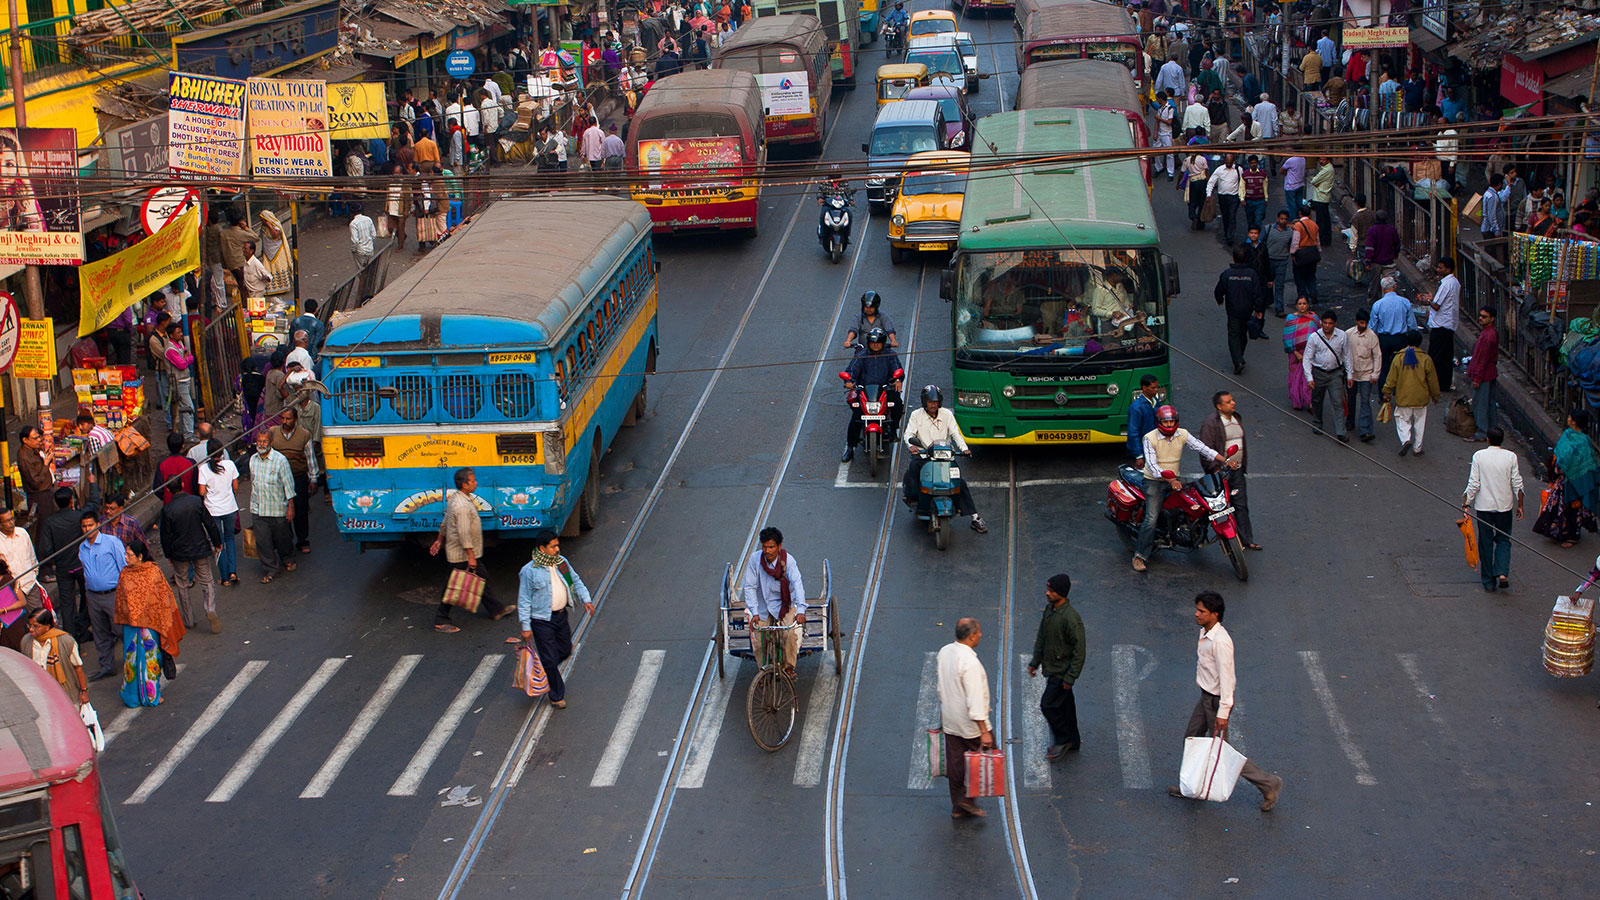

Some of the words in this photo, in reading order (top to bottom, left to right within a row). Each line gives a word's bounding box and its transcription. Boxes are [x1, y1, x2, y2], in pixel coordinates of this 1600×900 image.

[1367, 30, 1391, 38] Meghraj
[170, 75, 245, 108] ABHISHEK
[249, 81, 284, 97] ROYAL
[286, 83, 323, 98] TOUCH
[171, 99, 241, 118] SHERWANI
[249, 99, 296, 112] CREATIONS
[297, 100, 308, 113] (P)
[192, 116, 216, 126] HOUSE
[217, 120, 227, 128] OF
[173, 122, 211, 135] EXCLUSIVE
[212, 129, 238, 141] KURTA,
[172, 131, 193, 141] DHOTI
[210, 138, 239, 150] BLAZAR,
[255, 132, 324, 156] Raymond
[170, 141, 186, 150] SUIT
[188, 143, 193, 151] &
[195, 145, 217, 154] PARTY
[218, 149, 240, 159] DRESS
[214, 157, 233, 166] Street
[258, 157, 289, 166] ETHNIC
[291, 158, 315, 166] WEAR
[317, 159, 323, 167] &
[254, 166, 281, 175] DRESS
[283, 167, 328, 177] MATERIALS
[14, 233, 51, 247] Meghraj
[53, 234, 61, 244] &
[64, 234, 79, 244] Co.
[451, 440, 466, 448] BANK
[466, 444, 478, 453] LTD
[342, 517, 385, 530] Horn
